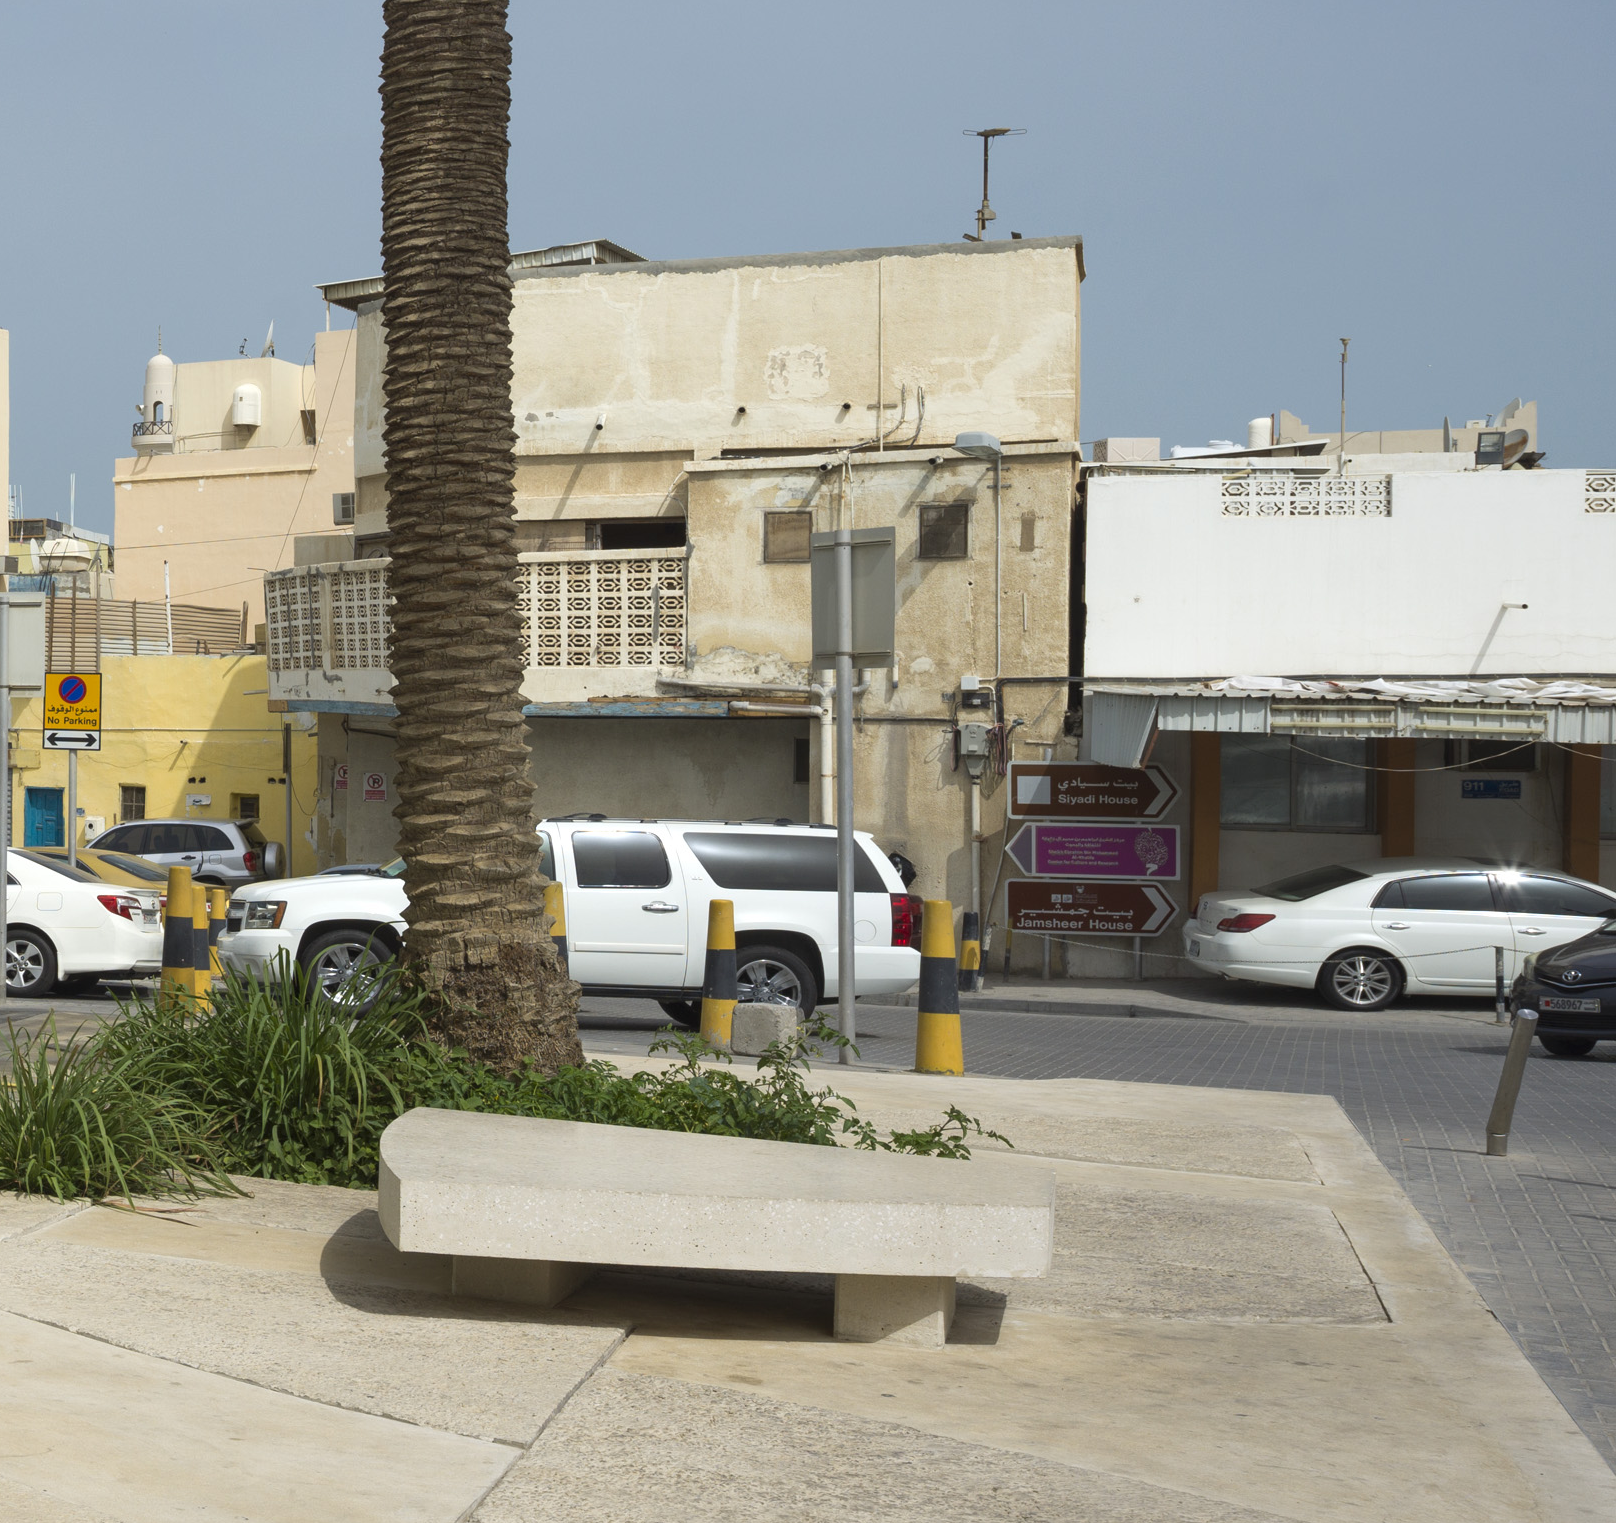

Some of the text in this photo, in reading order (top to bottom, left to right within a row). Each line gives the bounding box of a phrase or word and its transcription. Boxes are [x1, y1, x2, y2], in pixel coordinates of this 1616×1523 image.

[48, 704, 97, 716] ممنوع الوقوف
[64, 717, 97, 727] Parking
[1058, 777, 1138, 791] بيت سيادي
[1464, 781, 1484, 791] 911
[1058, 794, 1138, 805] Siyadi House
[1017, 904, 1134, 919] بيت جمشير
[1016, 917, 1133, 930] Jamsheer House
[1551, 999, 1583, 1010] 568967
